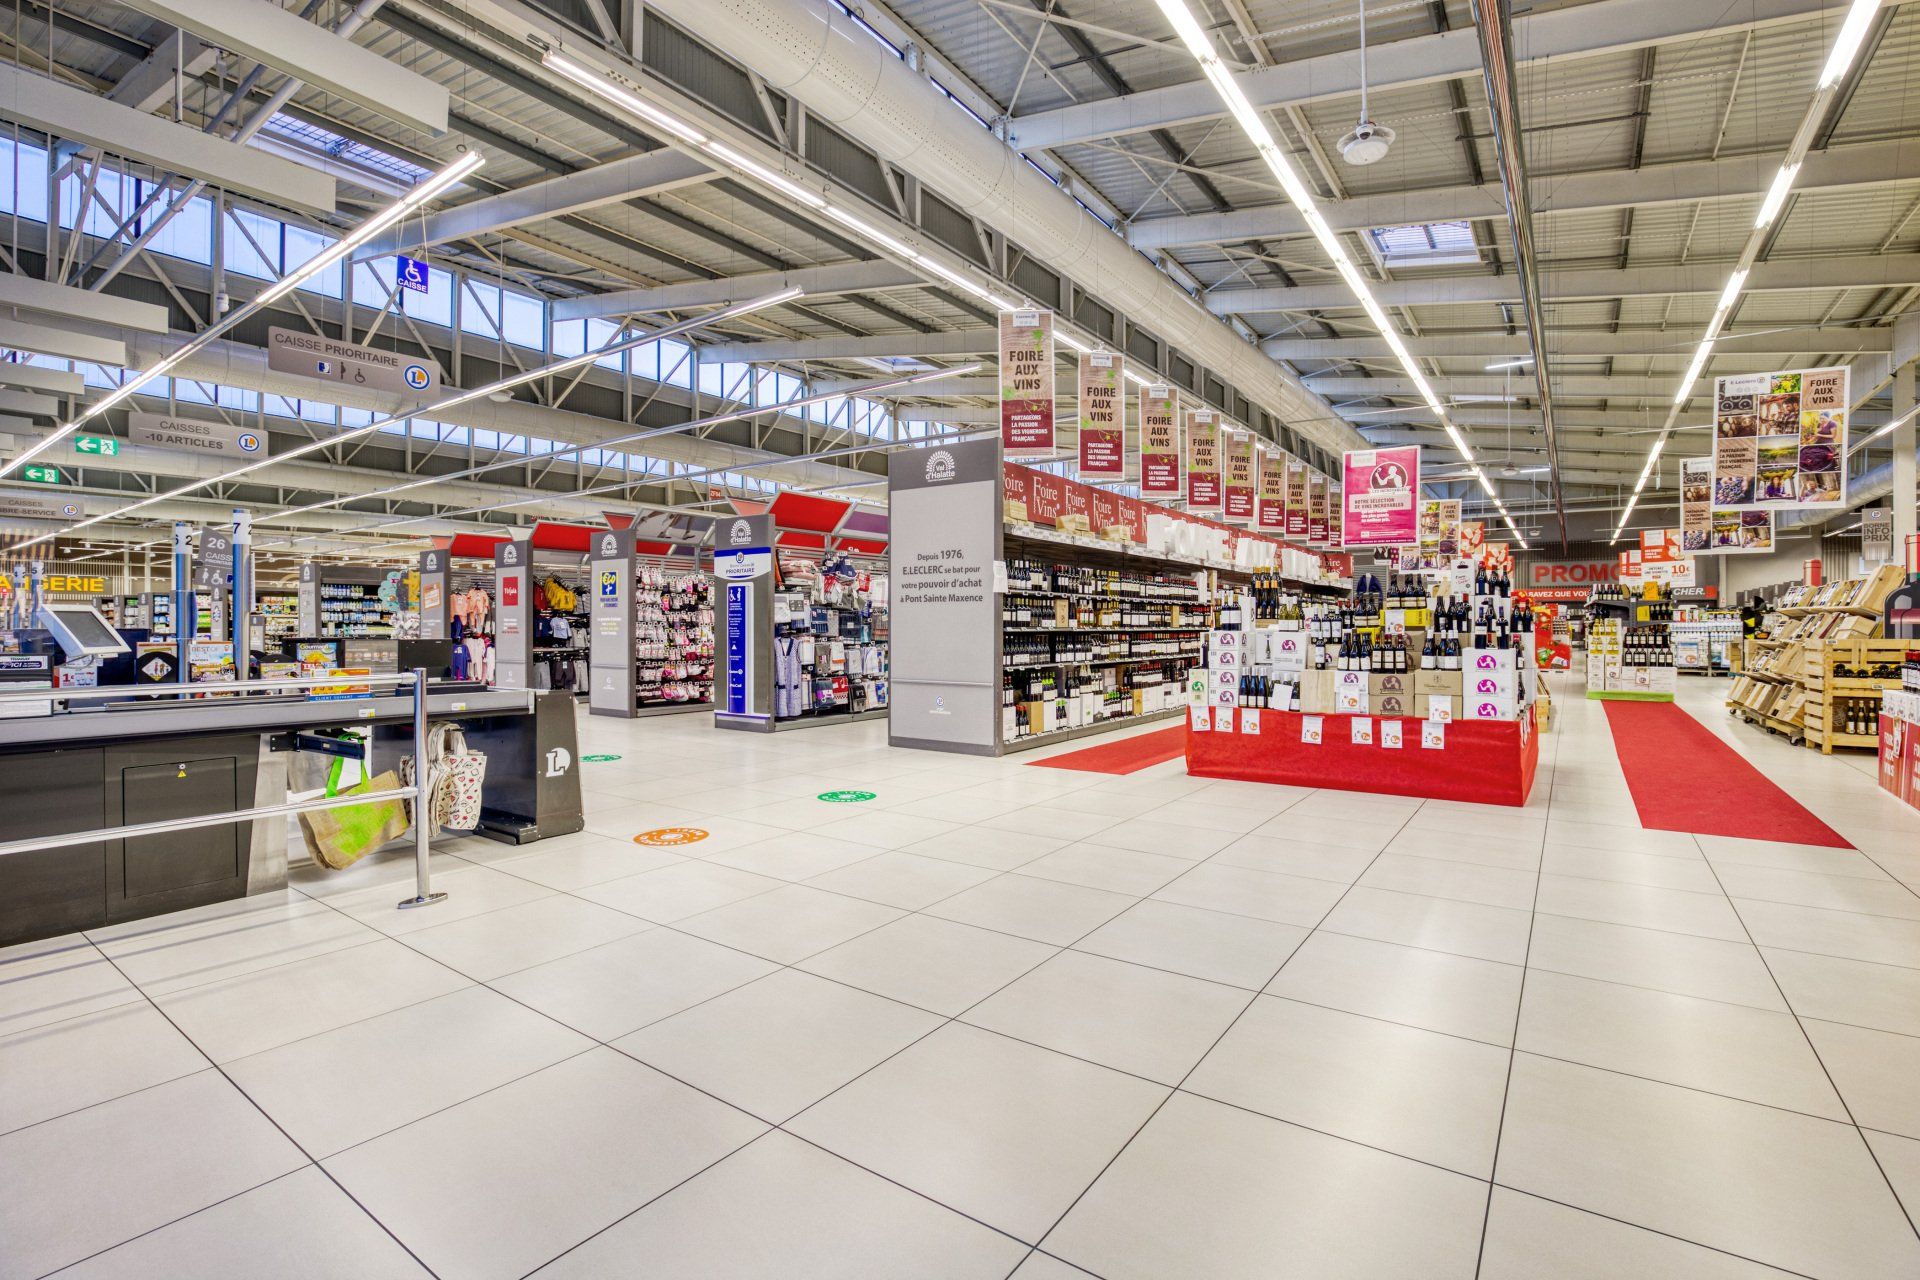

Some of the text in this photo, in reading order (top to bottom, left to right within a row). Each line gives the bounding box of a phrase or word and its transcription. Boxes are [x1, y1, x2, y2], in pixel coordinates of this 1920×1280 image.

[397, 277, 427, 293] CAISSE
[274, 333, 399, 367] CAISSE PRIORITAIRE
[1009, 350, 1044, 361] FOIRE
[1015, 365, 1038, 375] AUX
[1013, 379, 1041, 390] VINS
[1810, 378, 1838, 387] FOIRE
[1087, 387, 1116, 397] FOIRE
[1814, 387, 1833, 395] AUX
[1091, 399, 1111, 409] AUX
[1812, 395, 1834, 404] VINS
[1090, 412, 1113, 422] VINS
[1146, 416, 1172, 425] FOIRE
[160, 420, 211, 435] CAISSES
[1151, 427, 1168, 436] AUX
[145, 433, 223, 450] -10 ARTICLES
[1150, 438, 1170, 447] VINS
[1193, 438, 1215, 447] FOIRE
[1197, 448, 1212, 456] AUX
[1195, 458, 1213, 466] VINS
[1230, 455, 1250, 463] FOIRE
[1033, 476, 1058, 501] Foire
[8, 499, 44, 508] CAISSES
[1037, 498, 1057, 518] Vins
[185, 534, 193, 546] 2
[1863, 534, 1890, 542] PRIX
[207, 537, 226, 550] 26
[917, 549, 964, 562] Depuis 1976,
[902, 565, 943, 575] E.LECLERC
[952, 566, 963, 574] bat
[965, 566, 980, 576] pour
[918, 579, 949, 590] pouvoir
[951, 578, 982, 588] d'achat
[1554, 590, 1571, 598] QUE
[1673, 587, 1706, 596] CHER.
[905, 594, 922, 603] Pont
[923, 593, 947, 603] Sainte
[948, 593, 983, 602] Maxence
